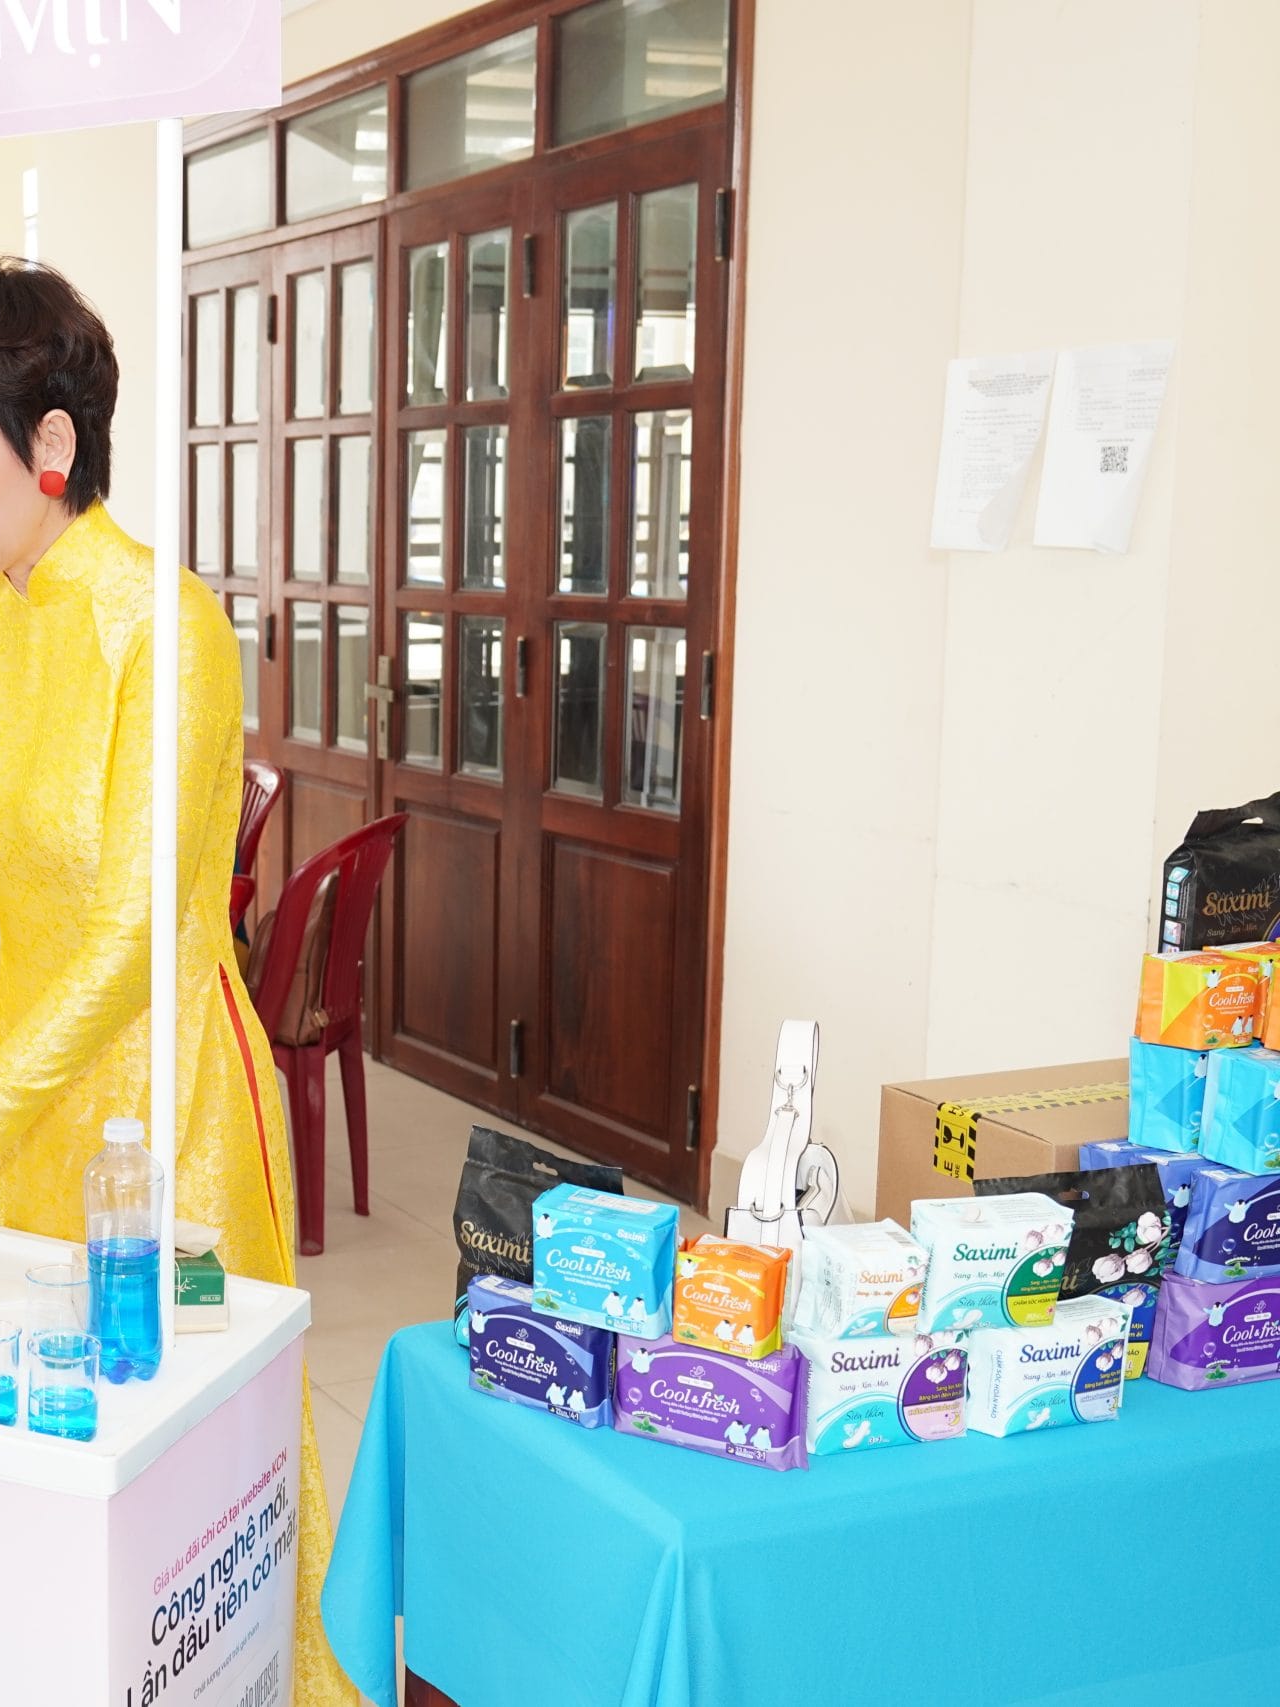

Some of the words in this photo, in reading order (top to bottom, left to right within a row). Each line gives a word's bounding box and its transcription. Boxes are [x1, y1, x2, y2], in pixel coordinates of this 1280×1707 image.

[1202, 885, 1271, 916] Saximi
[1209, 992, 1232, 1007] Cool
[461, 1220, 532, 1264] Saximi
[1243, 1222, 1276, 1242] Cool
[546, 1249, 584, 1272] Cool
[592, 1260, 631, 1281] fresh
[952, 1242, 1019, 1262] Saximi
[860, 1268, 904, 1284] Saximi
[952, 1272, 971, 1280] Sang
[682, 1284, 712, 1304] Cool
[719, 1293, 752, 1312] fresh
[1223, 1325, 1254, 1344] Cool
[485, 1340, 518, 1364] Cool
[524, 1353, 558, 1377] fresh
[830, 1347, 901, 1373] Saximi
[1019, 1339, 1081, 1363] Saximi
[746, 1358, 778, 1373] Saximi
[1023, 1374, 1041, 1382] Sang
[650, 1379, 691, 1404] Cool
[698, 1391, 740, 1415] fresh
[839, 1383, 856, 1392] Sang
[153, 1566, 170, 1596] Giá
[185, 1538, 200, 1565] đãi
[216, 1511, 228, 1535] có
[228, 1498, 240, 1523] tại
[240, 1470, 271, 1511] website
[272, 1447, 287, 1478] KCN
[151, 1572, 206, 1647] Công
[210, 1514, 256, 1590] nghệ
[260, 1476, 289, 1539] mới.
[172, 1614, 210, 1677] đầu
[214, 1578, 248, 1633] tiên
[252, 1542, 271, 1591] có
[274, 1507, 298, 1567] mặt.
[254, 1649, 280, 1707] WEBSITE
